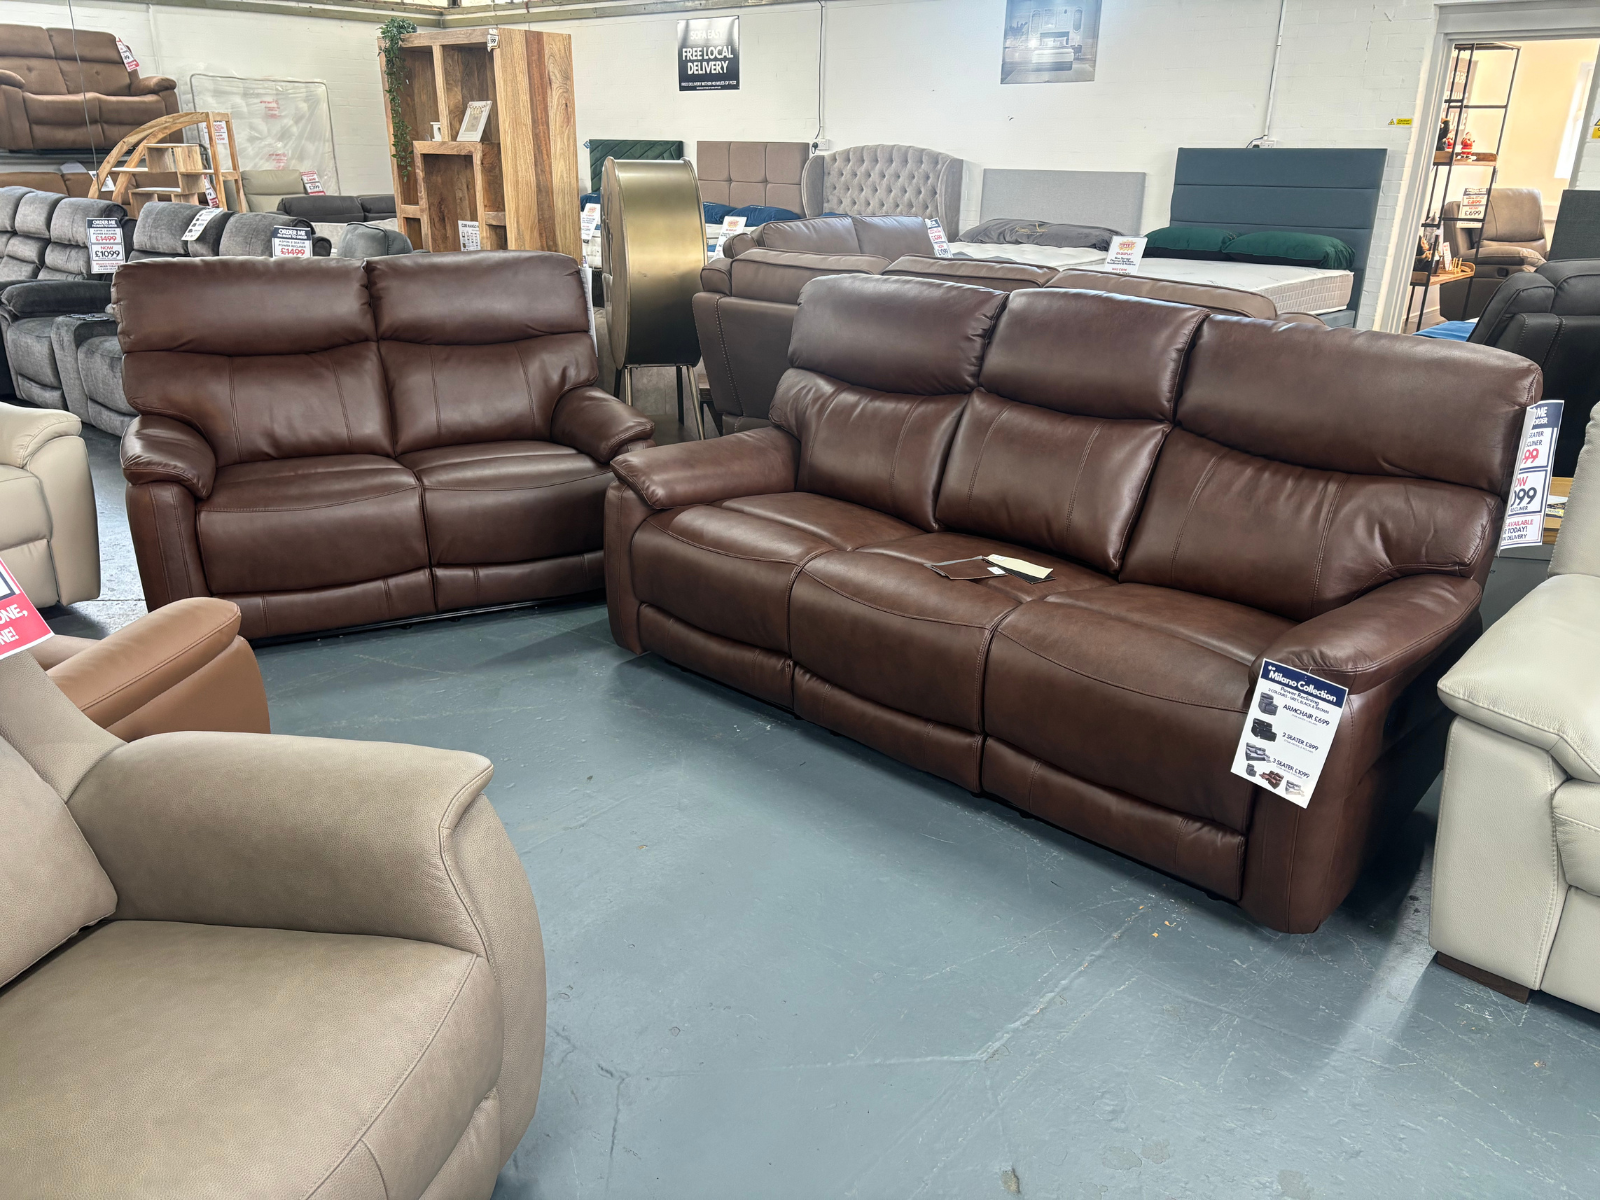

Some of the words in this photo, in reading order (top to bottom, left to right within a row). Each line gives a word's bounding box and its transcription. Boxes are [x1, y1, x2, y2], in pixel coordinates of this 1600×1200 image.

[683, 48, 702, 60] FREE
[704, 46, 733, 59] LOCAL
[688, 61, 729, 74] DELIVERY
[280, 248, 305, 256] £1499
[1508, 519, 1534, 527] AVAILABLE
[1269, 670, 1297, 687] Milano
[1298, 681, 1336, 703] Collection
[1280, 687, 1296, 696] Power
[1297, 693, 1320, 706] Reclining
[1283, 704, 1314, 720] ARMCHAIR
[1314, 716, 1330, 726] £699
[1287, 734, 1305, 745] SEATER
[1305, 742, 1319, 751] £899
[1276, 760, 1294, 771] SEATER
[1295, 768, 1310, 778] £1099
